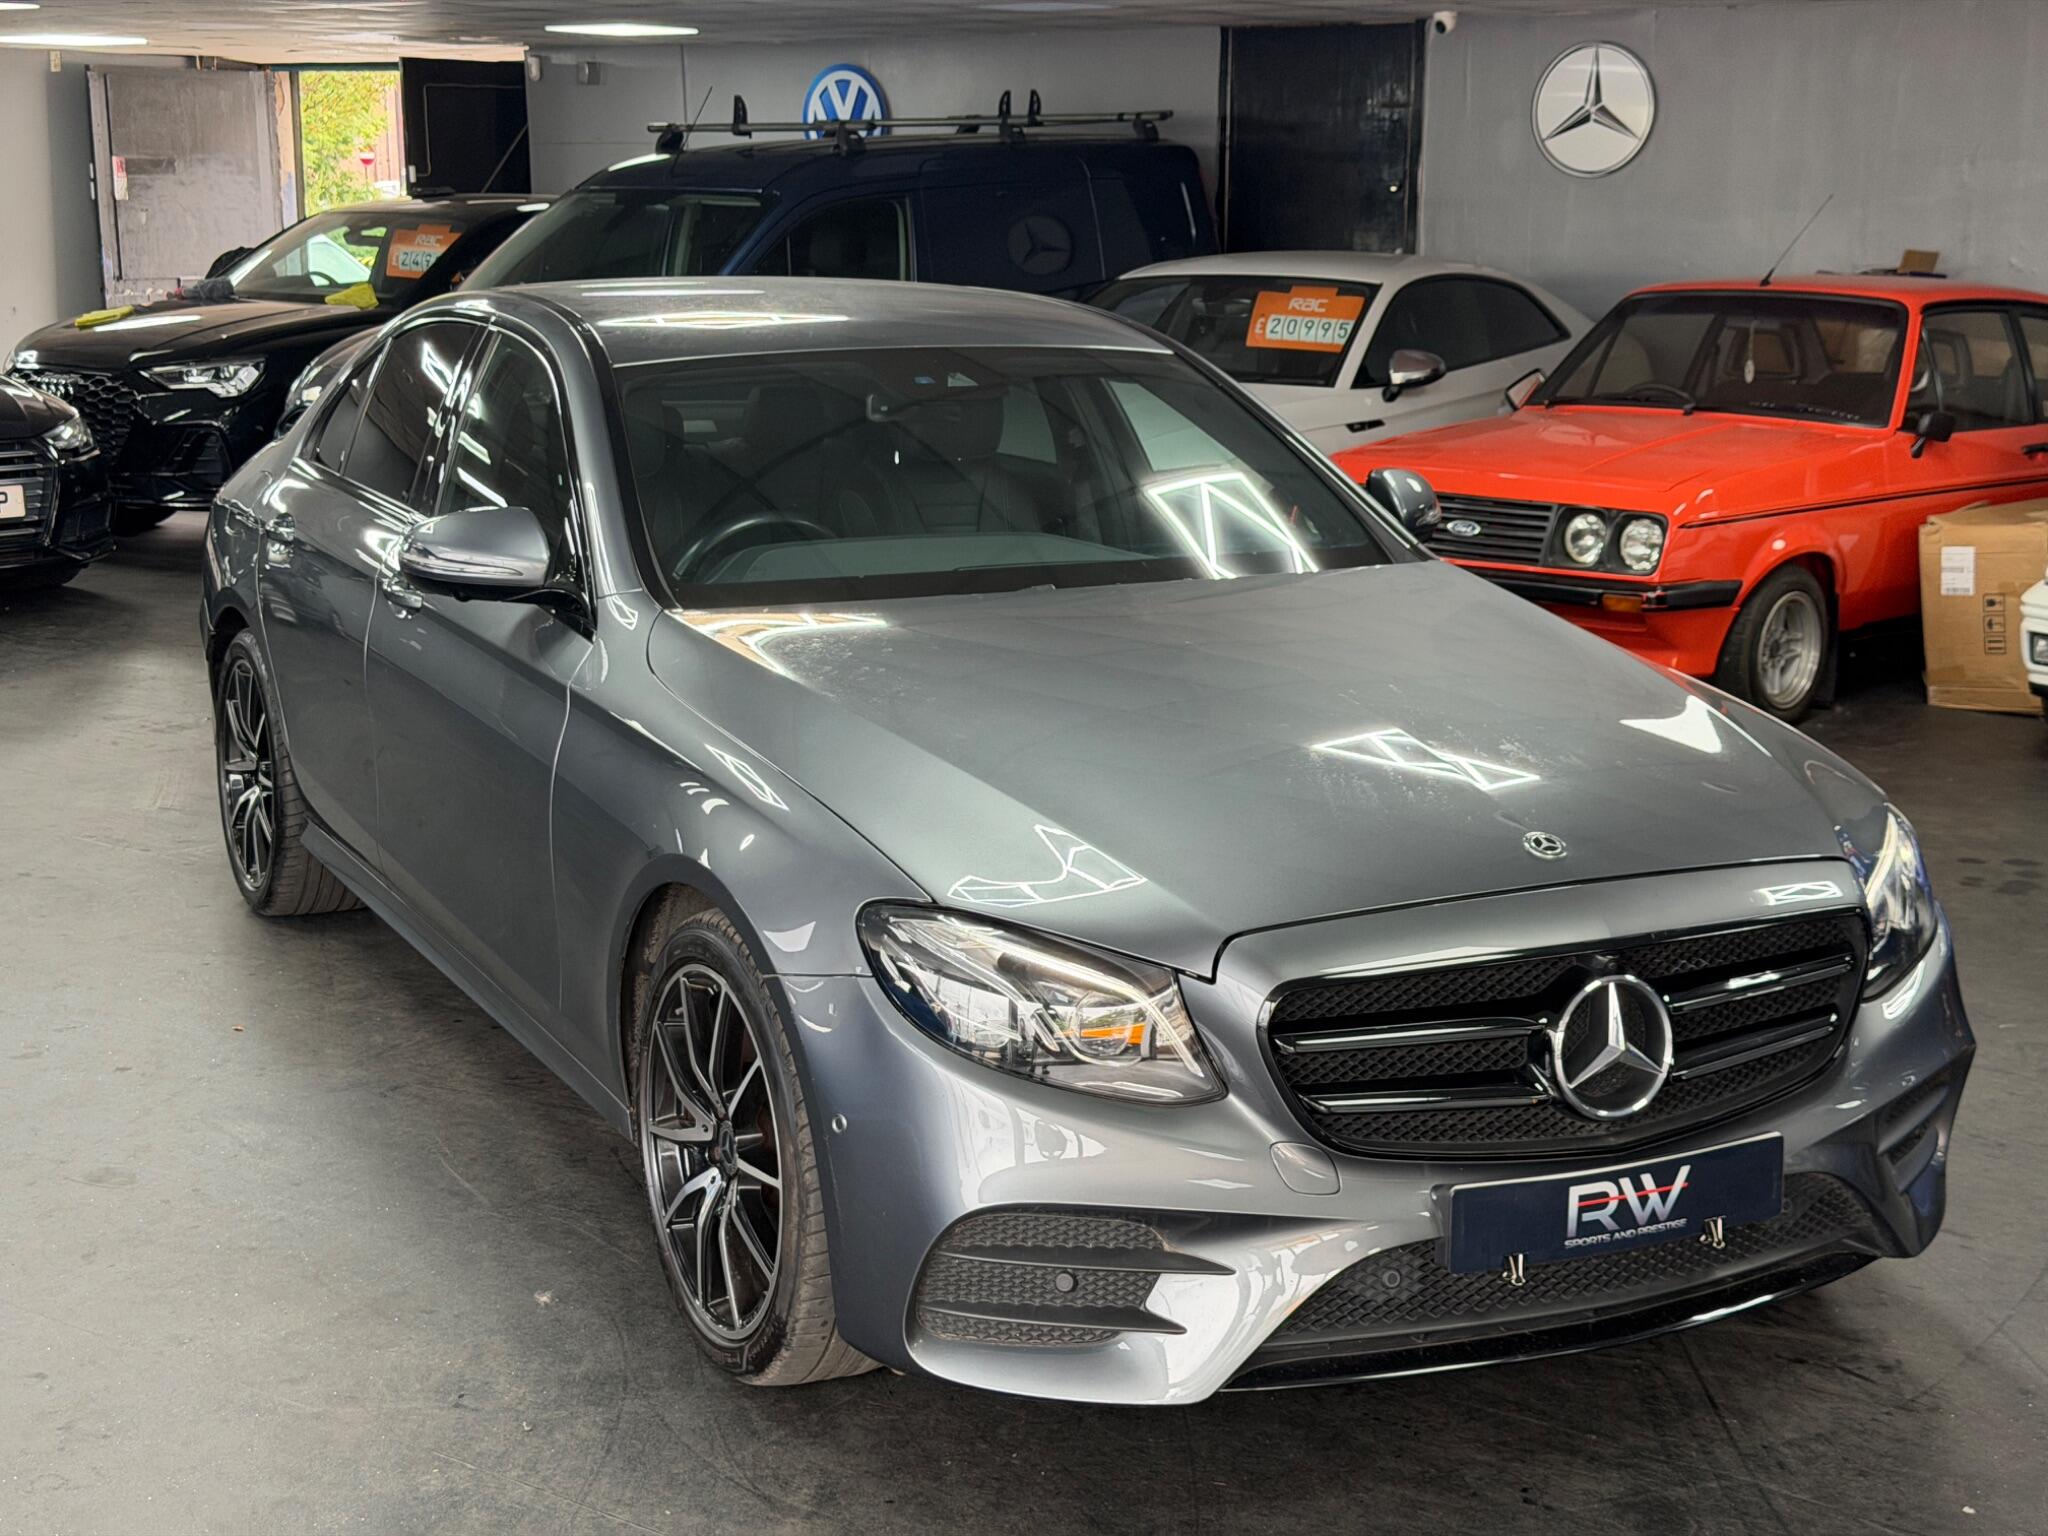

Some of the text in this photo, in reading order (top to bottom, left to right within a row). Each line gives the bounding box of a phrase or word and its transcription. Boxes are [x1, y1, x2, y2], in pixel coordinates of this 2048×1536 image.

[1567, 1165, 1691, 1238] RW
[1564, 1218, 1688, 1249] SPORTS AND PRESTIGE
